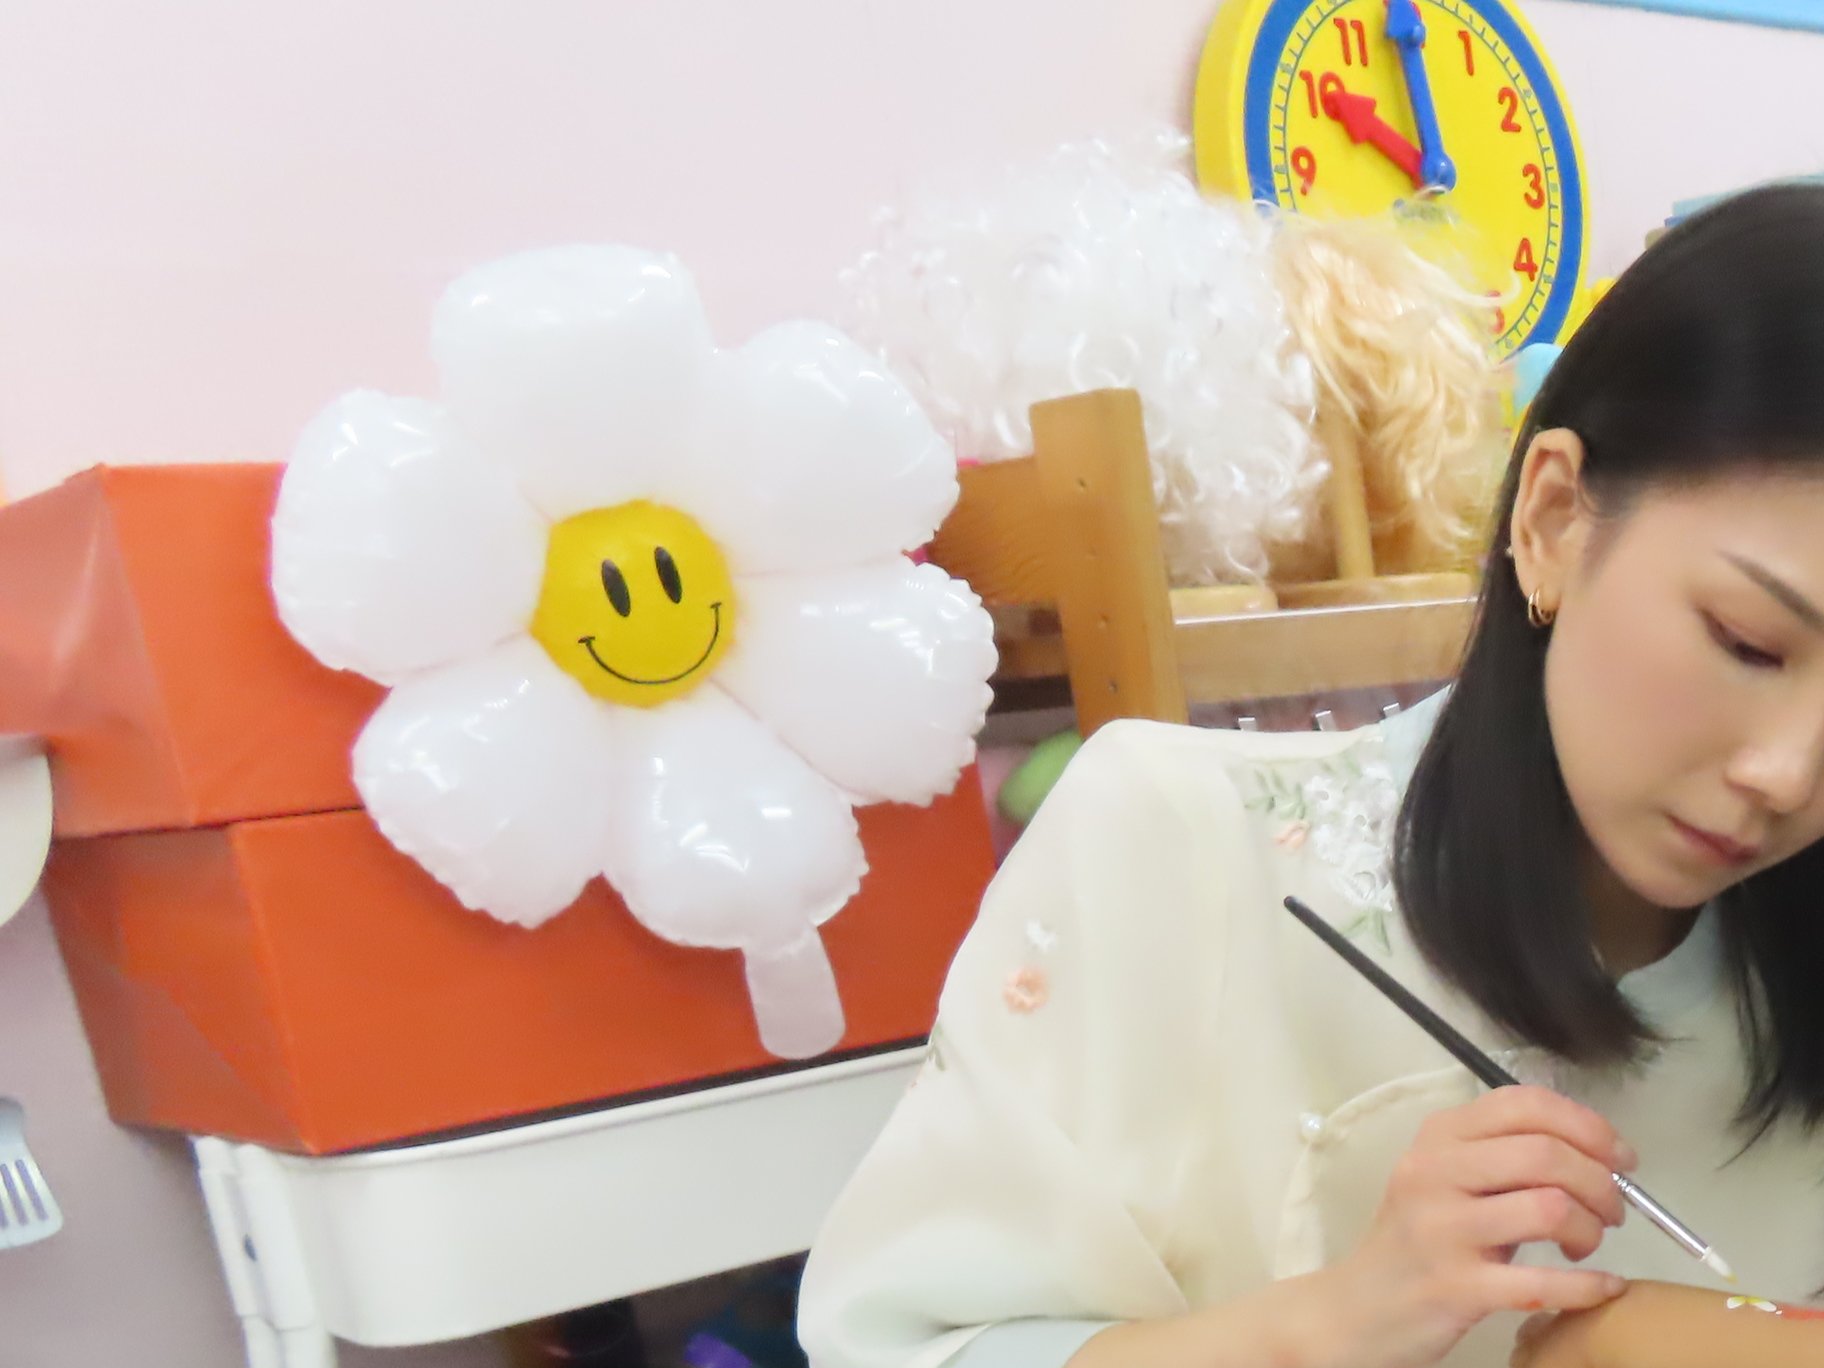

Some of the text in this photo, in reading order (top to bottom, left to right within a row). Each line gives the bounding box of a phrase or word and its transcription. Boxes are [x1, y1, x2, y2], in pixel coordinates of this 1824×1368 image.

[1333, 18, 1369, 67] 11
[1457, 30, 1474, 76] 1
[1299, 71, 1347, 122] 10
[1498, 87, 1521, 132] 2
[1291, 146, 1317, 196] 9
[1522, 163, 1545, 209] 3
[1513, 237, 1538, 281] 4
